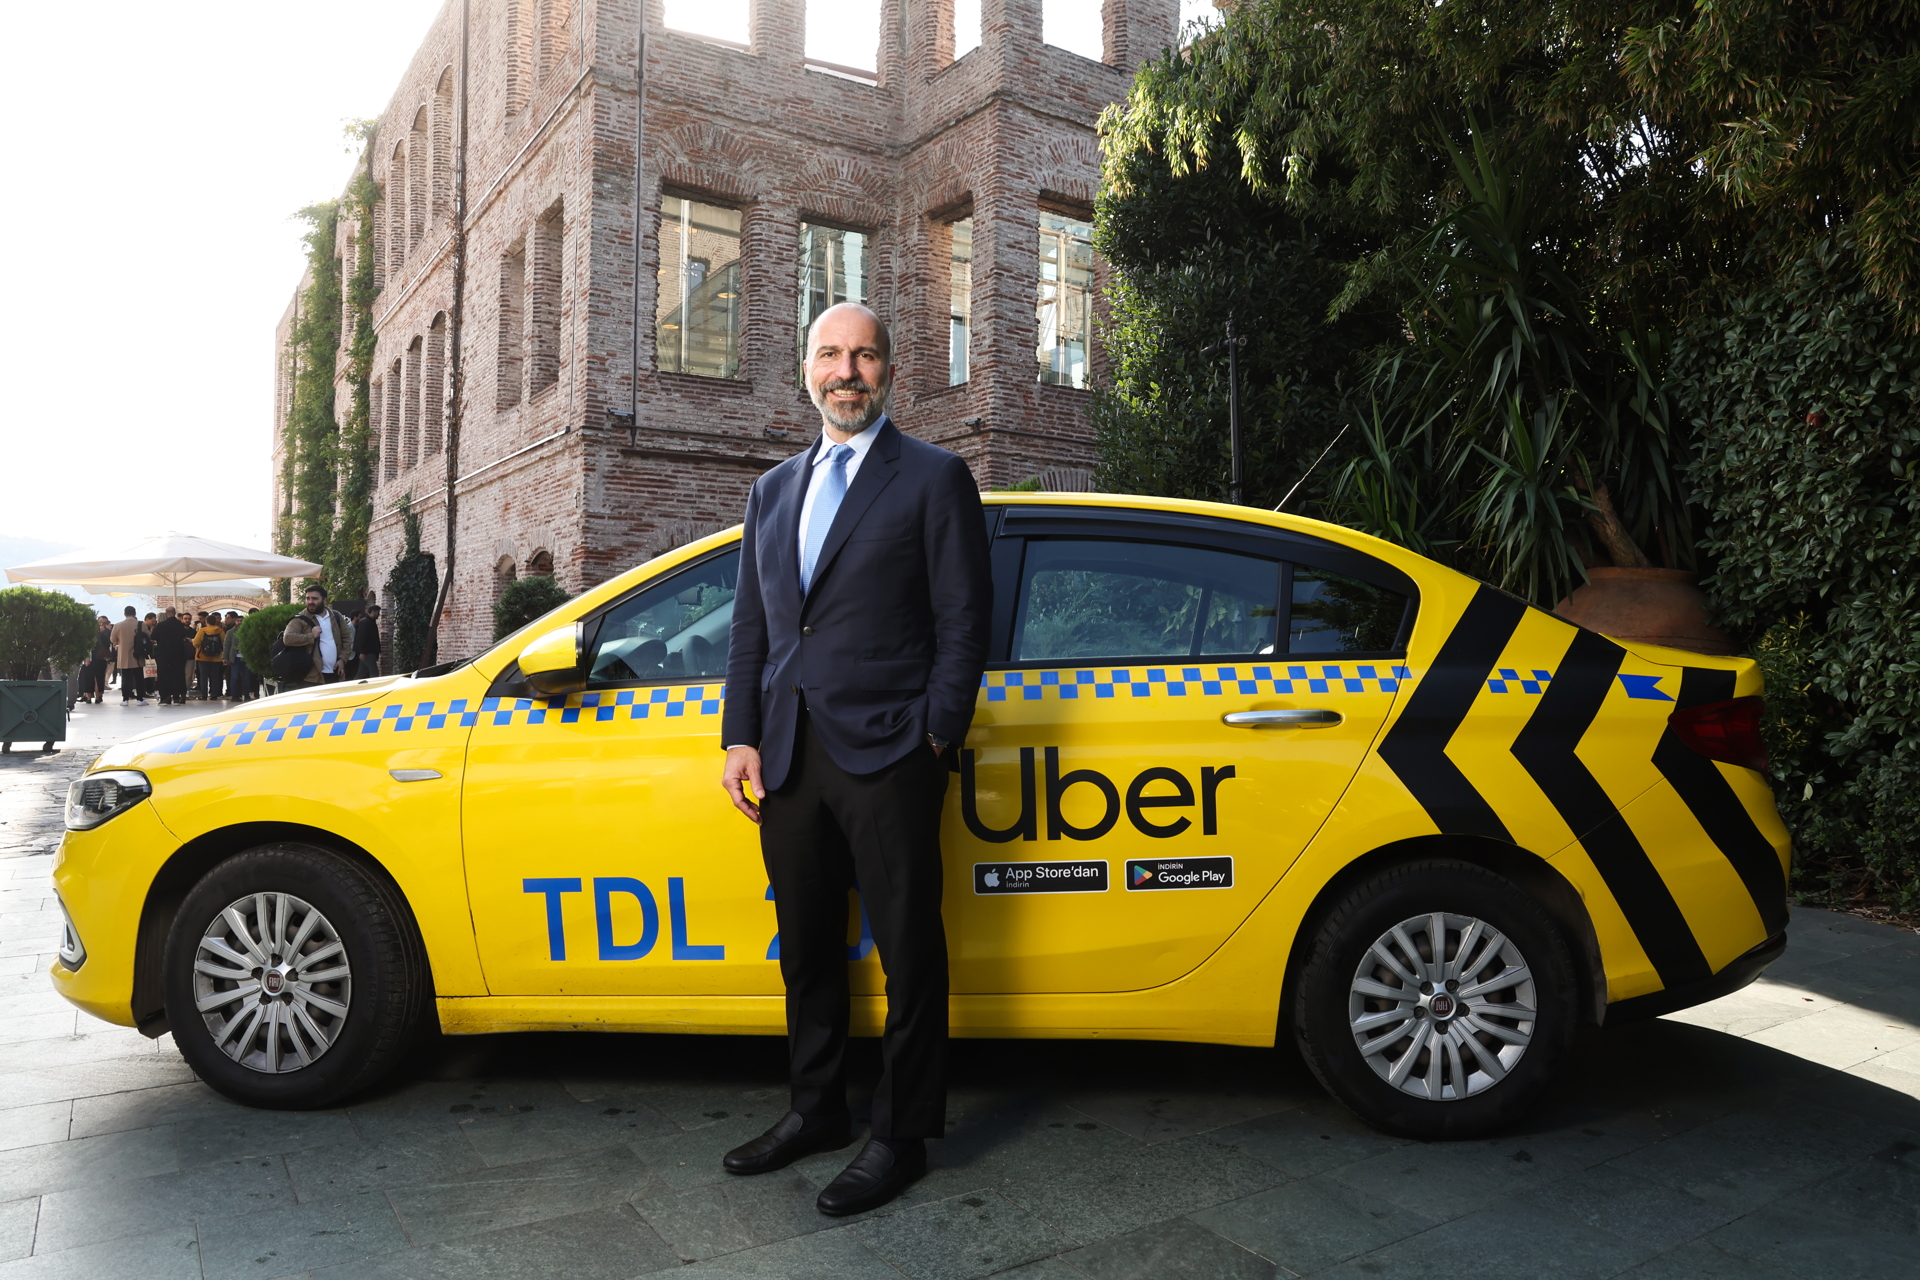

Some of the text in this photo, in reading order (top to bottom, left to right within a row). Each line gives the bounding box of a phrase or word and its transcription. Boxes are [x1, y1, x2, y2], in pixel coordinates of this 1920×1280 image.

[960, 746, 1236, 843] Uber
[1005, 867, 1033, 881] App
[1158, 870, 1225, 885] Google Play
[522, 877, 725, 961] TDL
[1435, 1000, 1448, 1011] FIAT
